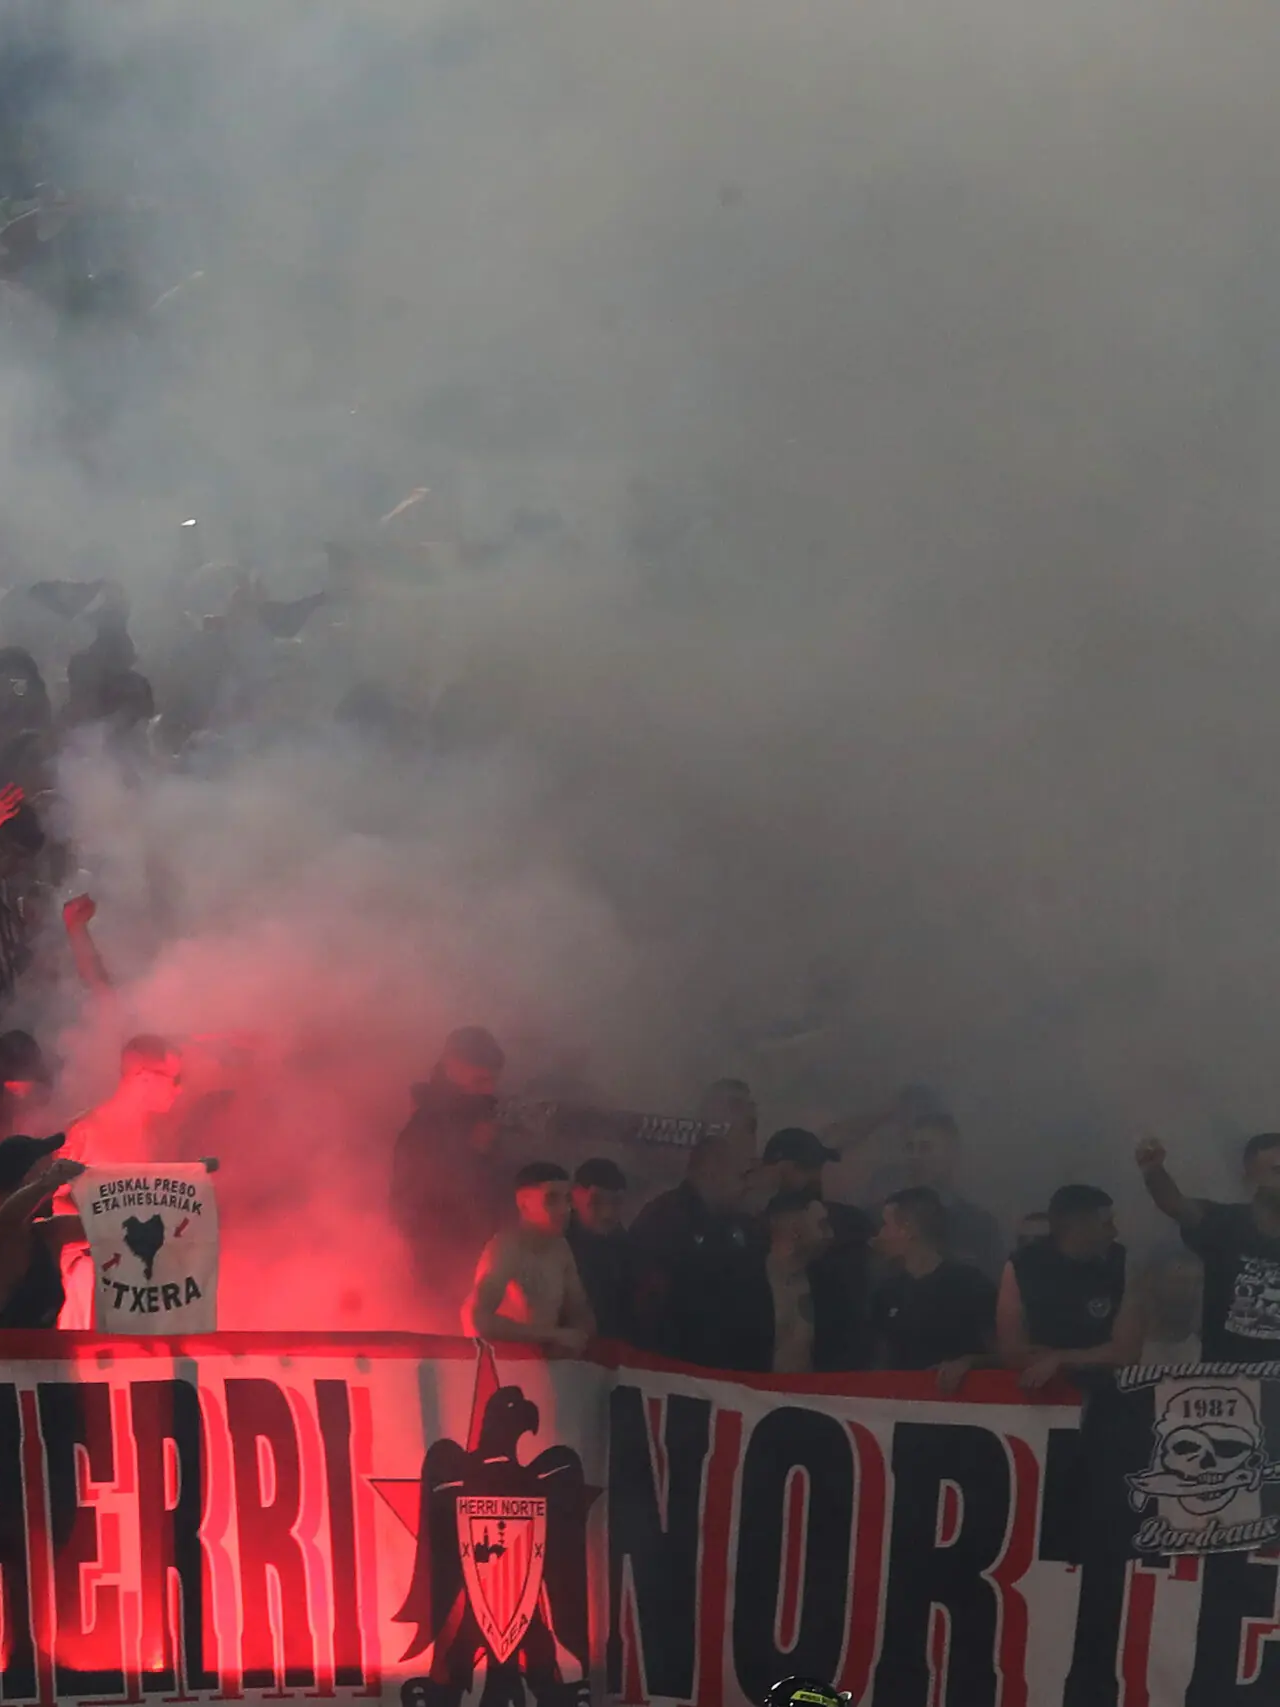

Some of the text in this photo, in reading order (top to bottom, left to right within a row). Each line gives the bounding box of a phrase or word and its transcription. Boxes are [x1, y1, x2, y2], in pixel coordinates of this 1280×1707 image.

[99, 1177, 197, 1198] EUSKAL PRESO
[92, 1191, 204, 1216] ETA IHESLARIAK
[1182, 1398, 1238, 1419] 1987
[458, 1499, 546, 1517] HERRI NORTE
[1133, 1516, 1280, 1552] Bordeaux
